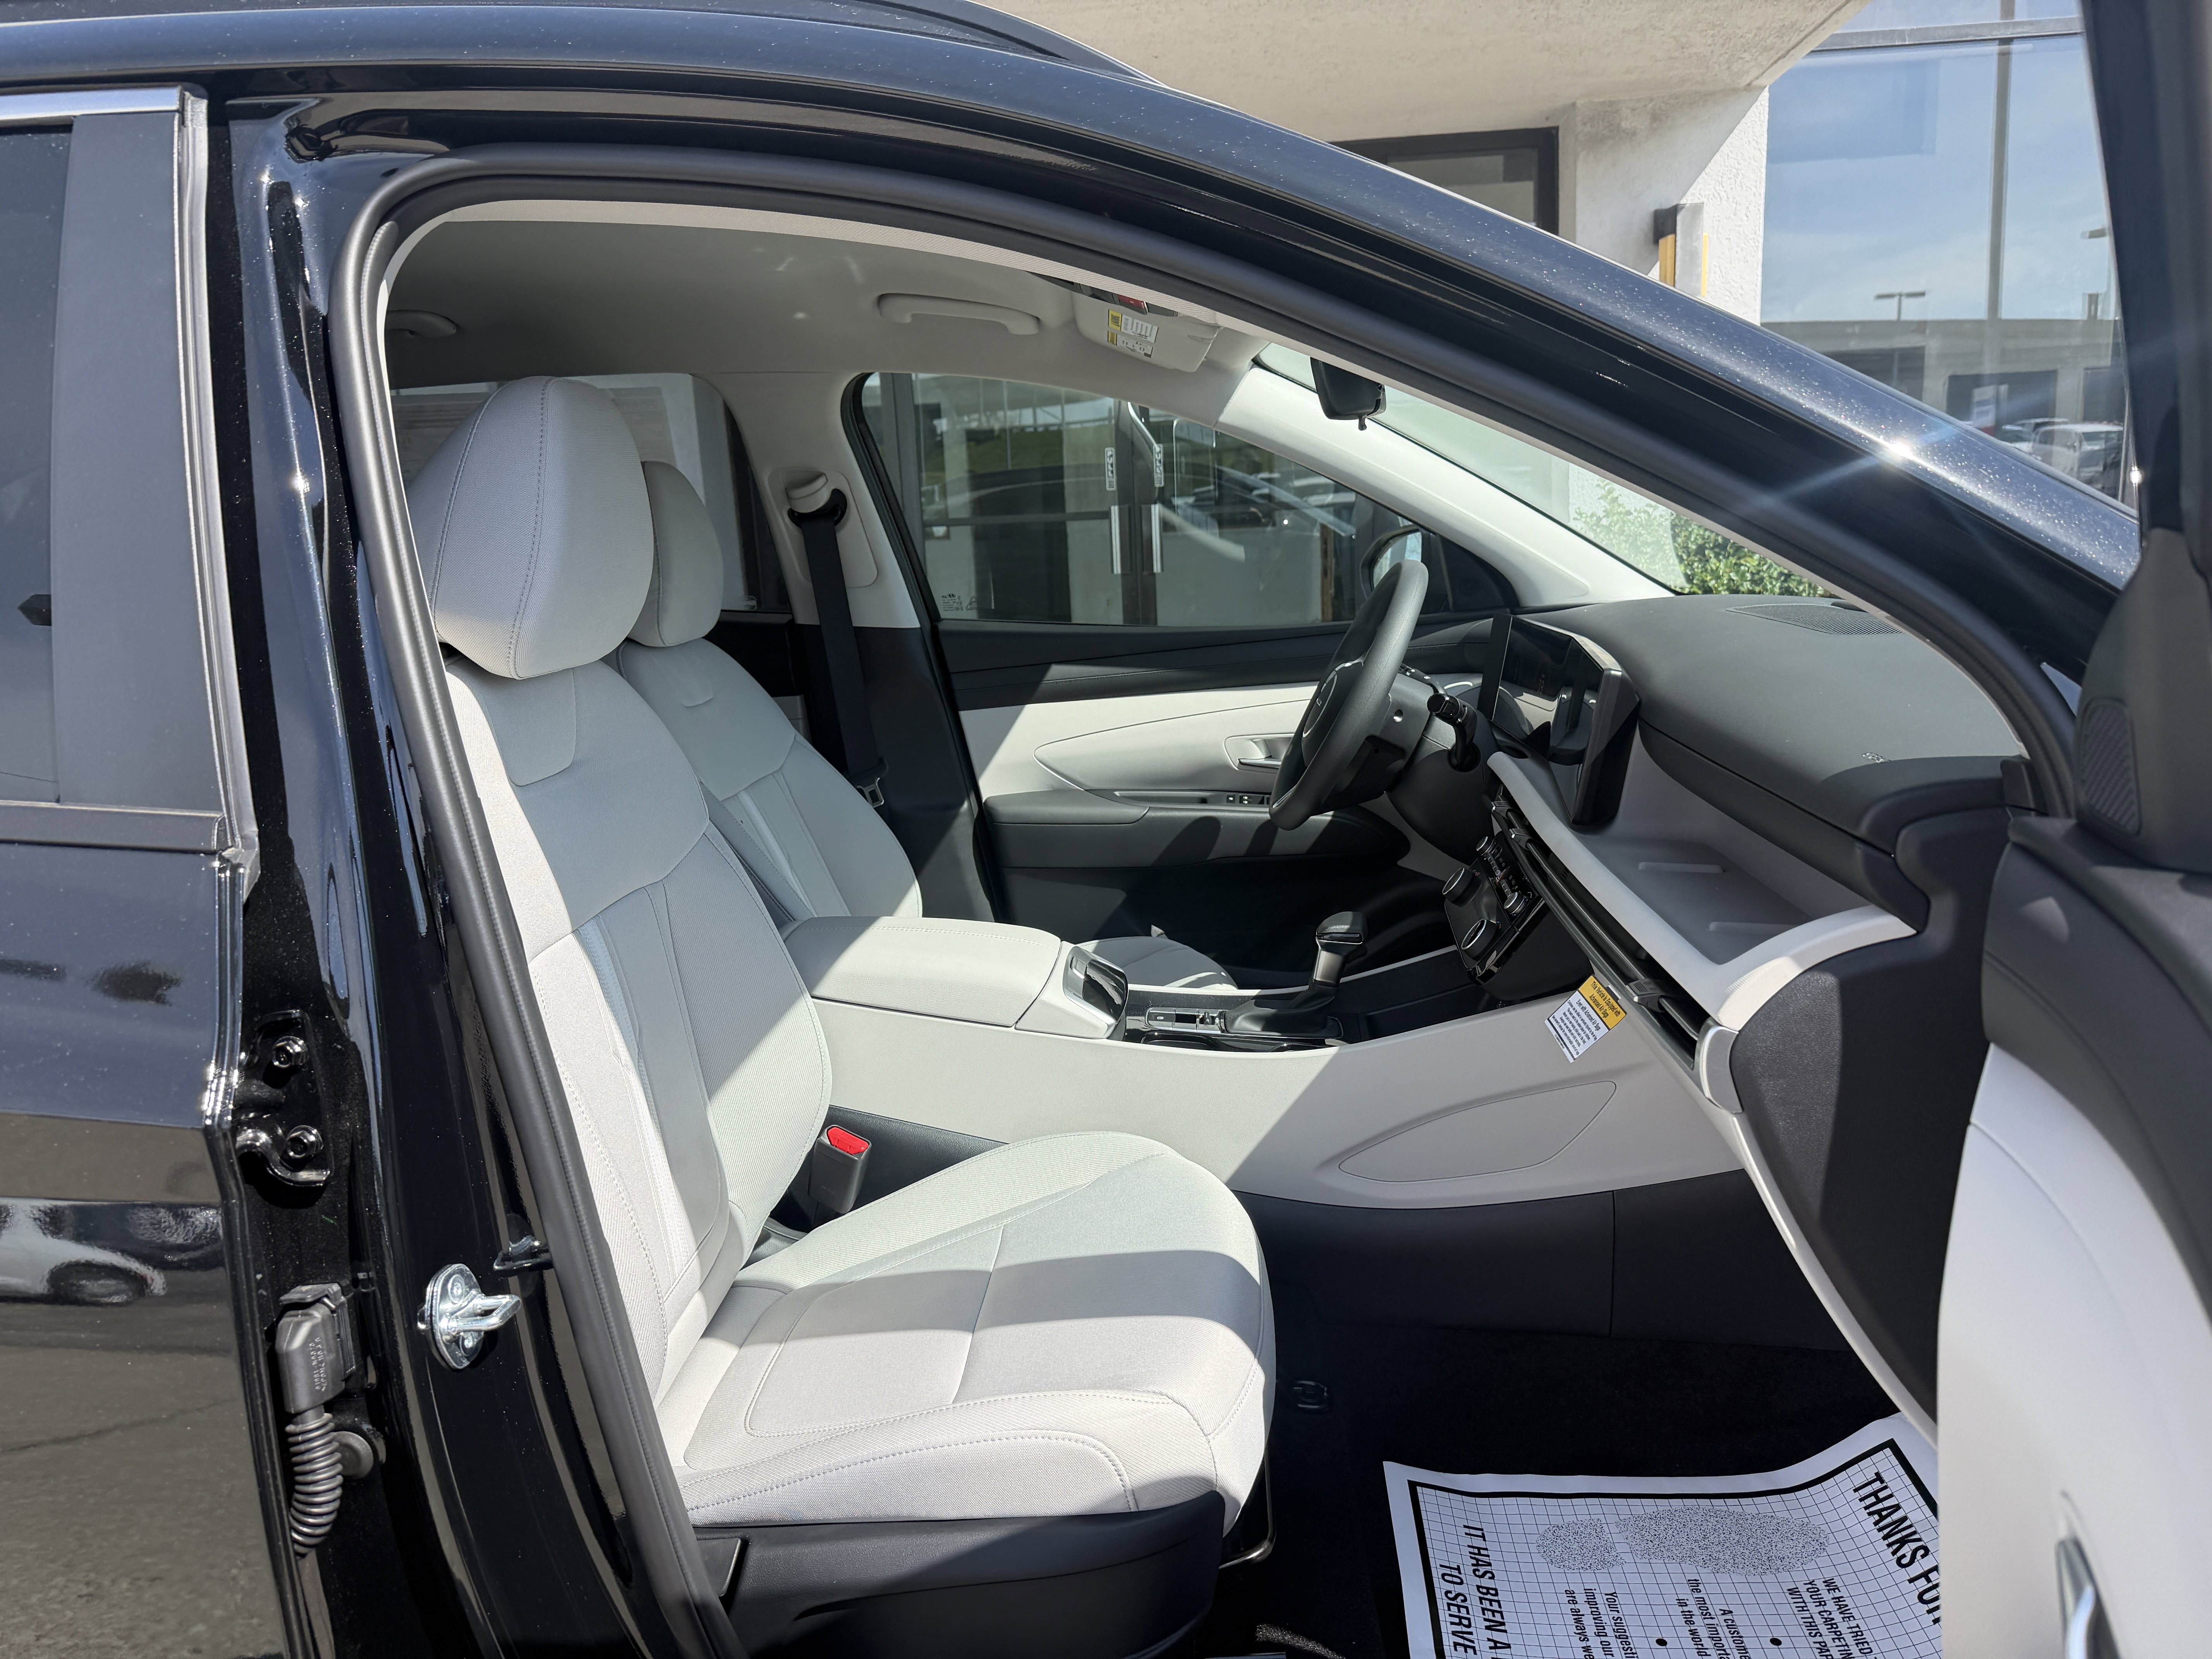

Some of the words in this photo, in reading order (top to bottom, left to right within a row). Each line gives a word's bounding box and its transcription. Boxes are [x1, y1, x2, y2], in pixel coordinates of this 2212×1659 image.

[1463, 1525, 1486, 1542] IT
[1853, 1472, 1929, 1568] THANKS
[1439, 1564, 1464, 1585] TO
[1467, 1545, 1495, 1580] HAS
[1565, 1590, 1578, 1604] are
[1688, 1579, 1702, 1593] the
[1695, 1597, 1715, 1620] most
[1822, 1578, 1841, 1594] WE
[1476, 1584, 1508, 1633] BEEN
[1605, 1592, 1620, 1613] Your
[1676, 1599, 1689, 1607] in
[1787, 1587, 1810, 1612] WITH
[1801, 1614, 1822, 1638] THIS
[1831, 1595, 1856, 1622] HAVE
[1444, 1590, 1477, 1655] SERVE
[1570, 1608, 1589, 1642] always
[1584, 1589, 1608, 1637] improving
[1600, 1641, 1614, 1657] our
[1681, 1610, 1695, 1625] the
[1803, 1580, 1827, 1607] YOUR
[1818, 1610, 1855, 1659] CARPETIN
[1487, 1637, 1511, 1650] A
[1581, 1645, 1594, 1659] we
[1688, 1628, 1711, 1656] world
[1846, 1623, 1873, 1655] TRIED
